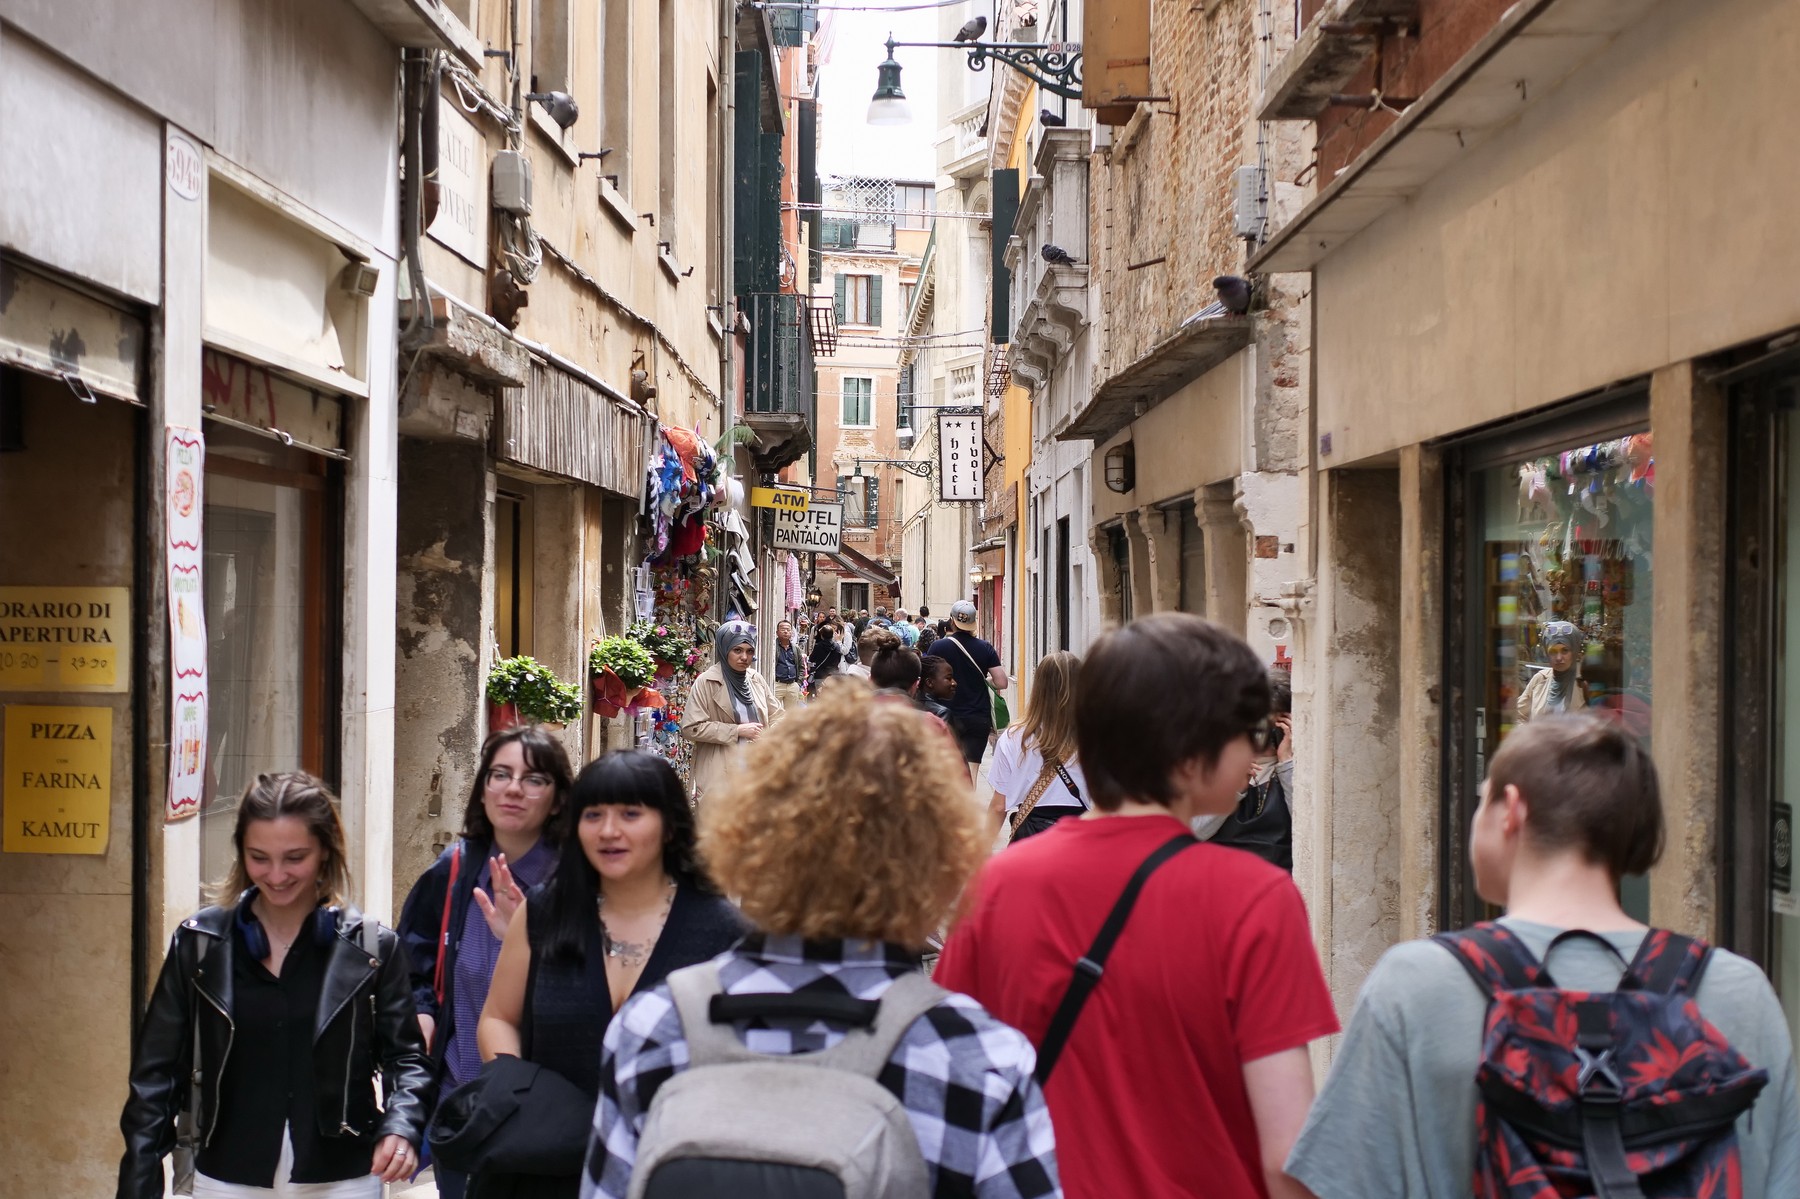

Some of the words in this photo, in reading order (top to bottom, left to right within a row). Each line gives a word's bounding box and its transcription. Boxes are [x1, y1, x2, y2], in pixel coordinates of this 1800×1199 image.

[439, 183, 474, 236] OVENE
[951, 438, 959, 495] hotel
[970, 421, 979, 495] tivoli
[772, 493, 805, 507] ATM
[779, 509, 838, 526] HOTEL
[775, 528, 838, 547] PANTALON
[0, 602, 82, 619] ORARIO
[87, 602, 111, 619] DI
[30, 723, 97, 740] PIZZA
[22, 772, 101, 789] FARINA
[22, 821, 100, 838] KAMUT
